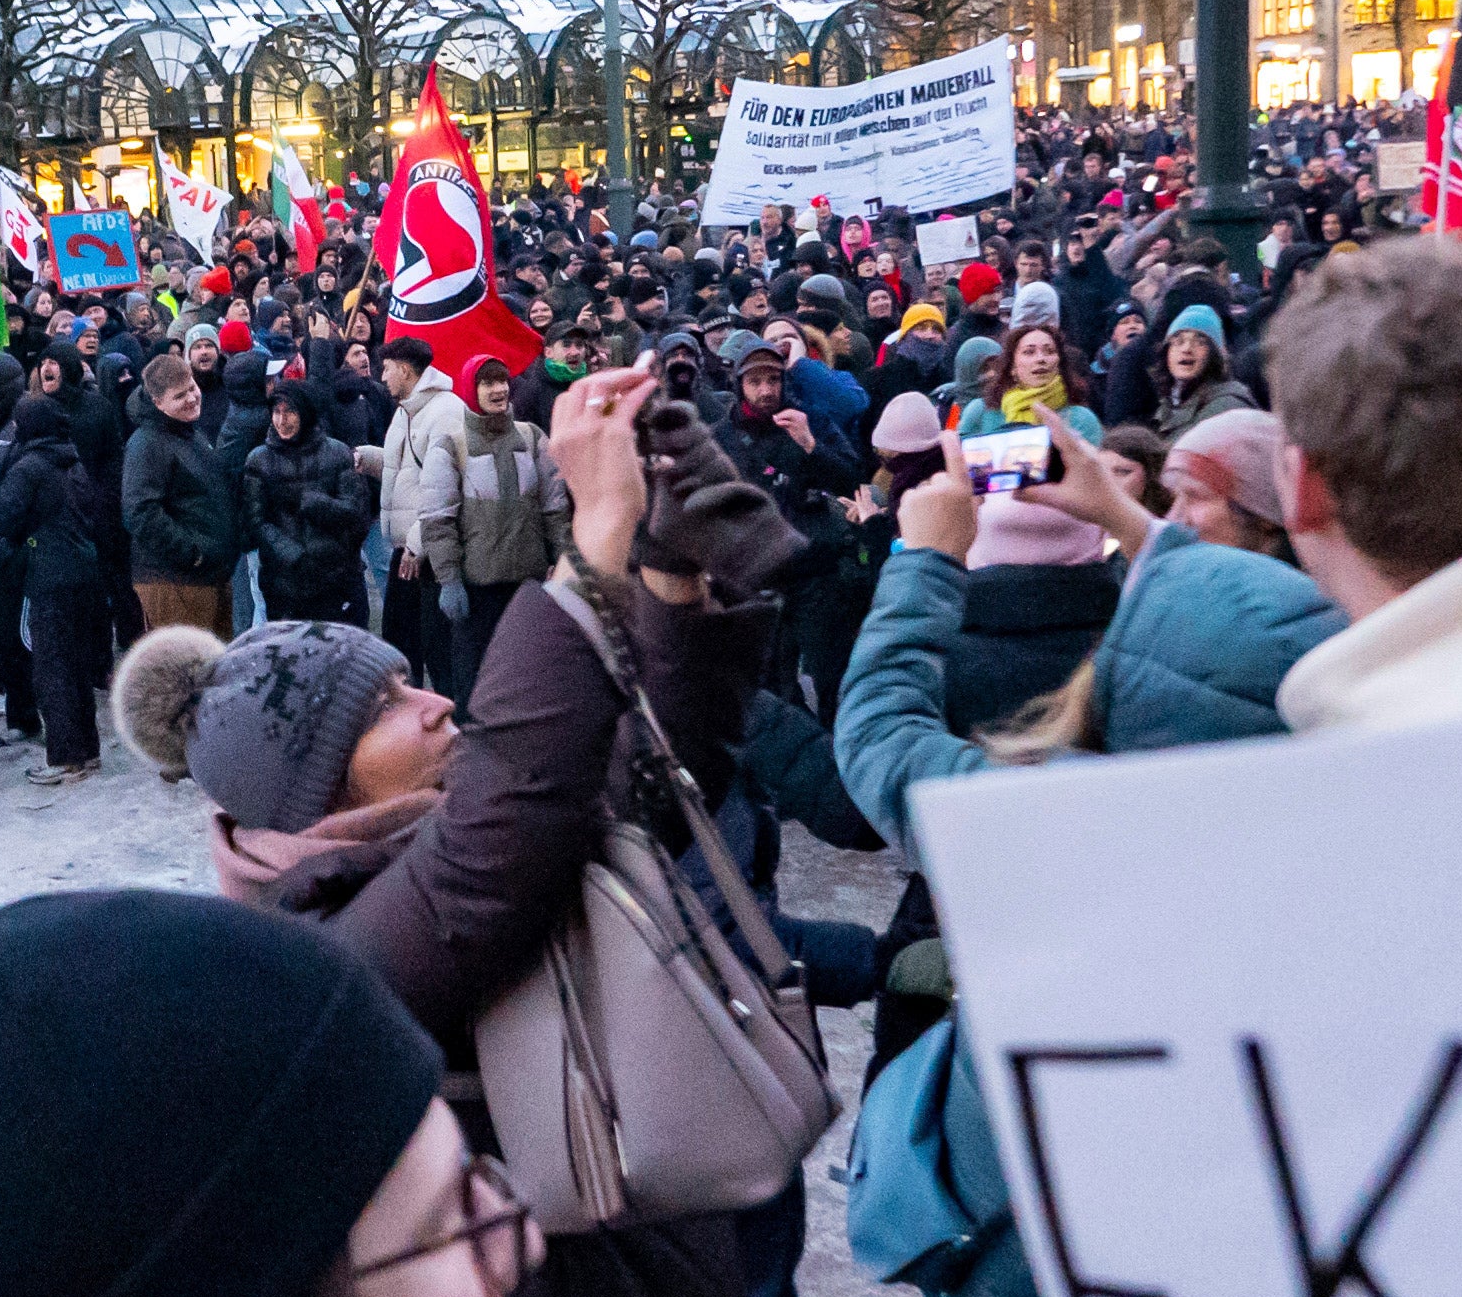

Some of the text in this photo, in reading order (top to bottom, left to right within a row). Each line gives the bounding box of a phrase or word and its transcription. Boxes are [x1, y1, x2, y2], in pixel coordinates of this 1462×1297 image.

[740, 97, 769, 122] FÜR
[772, 105, 805, 127] DEN
[911, 65, 995, 105] MAUERFALL
[746, 131, 810, 149] Solidarität
[62, 273, 98, 291] NEIN
